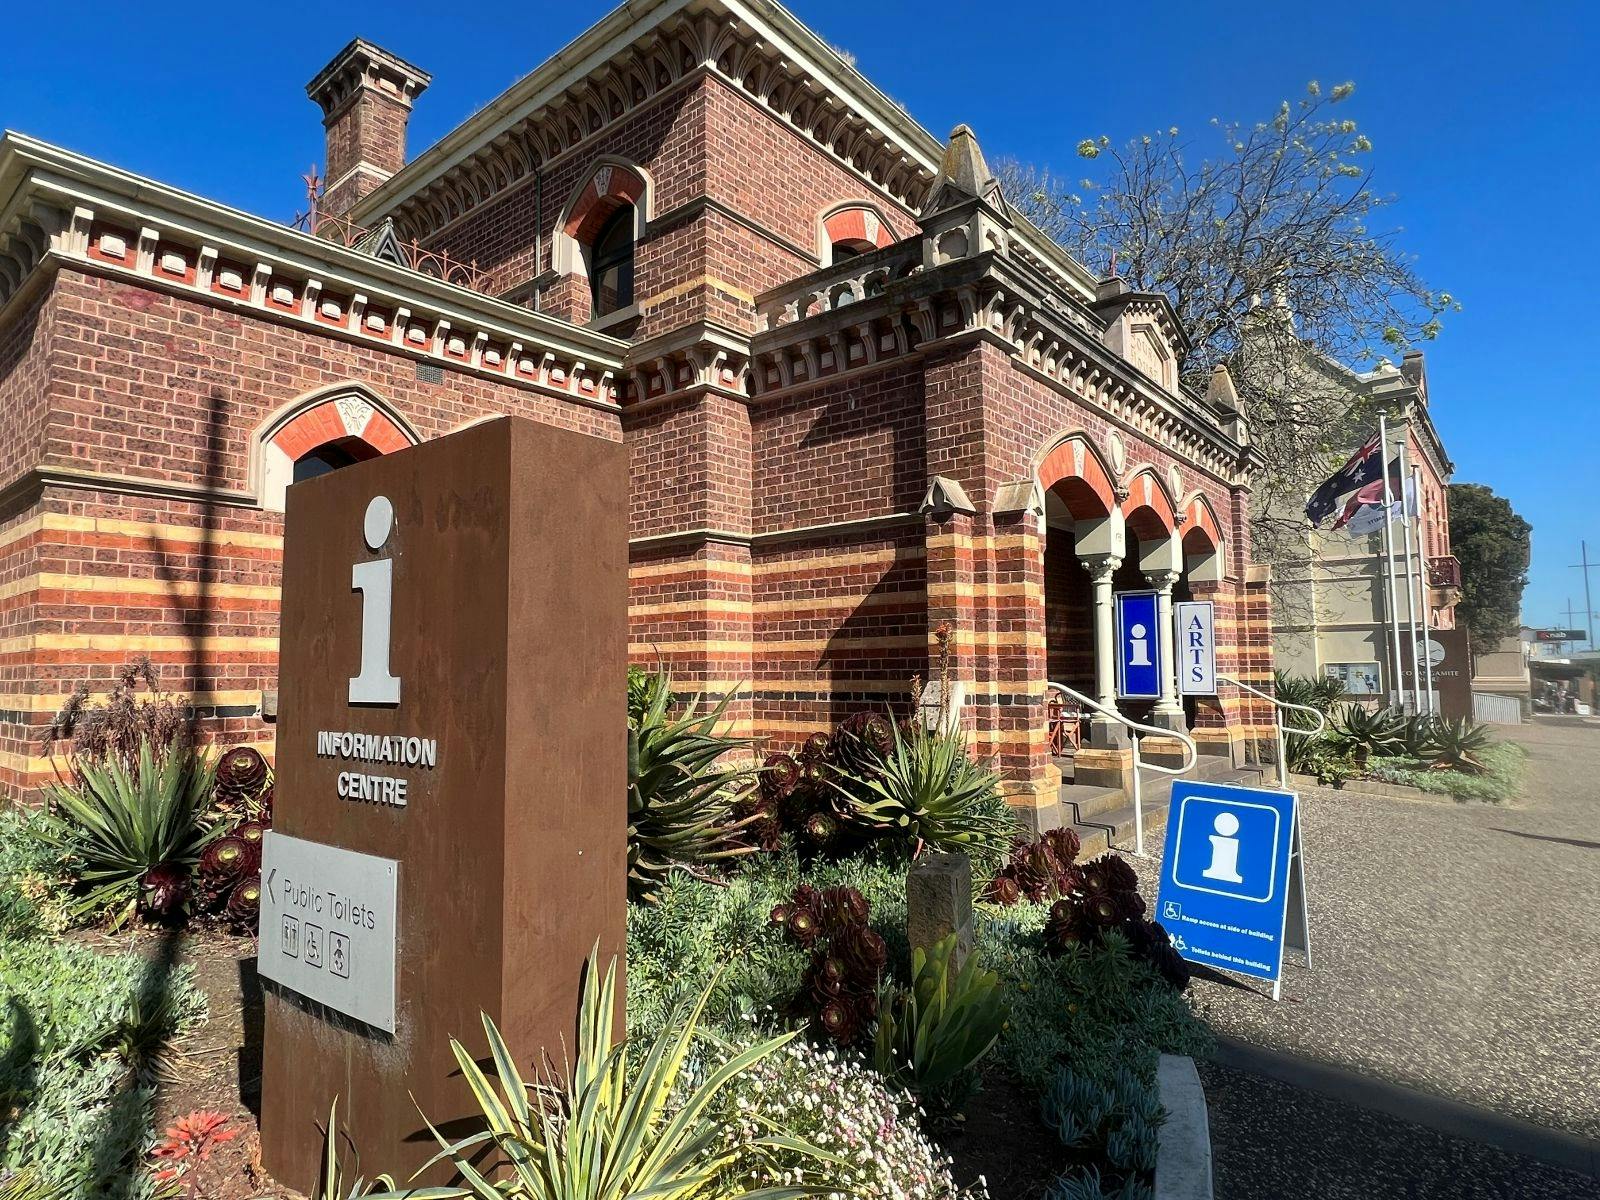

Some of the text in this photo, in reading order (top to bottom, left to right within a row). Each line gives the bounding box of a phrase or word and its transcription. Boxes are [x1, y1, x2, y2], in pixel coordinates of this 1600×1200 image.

[1188, 614, 1204, 683] ARTS
[317, 731, 437, 767] INFORMATION
[337, 771, 408, 806] CENTRE
[283, 878, 375, 930] Public Toilets
[1181, 915, 1199, 924] Ramp
[1227, 925, 1240, 933] side
[1248, 929, 1274, 941] building
[1191, 946, 1271, 972] Toilets behind this building
